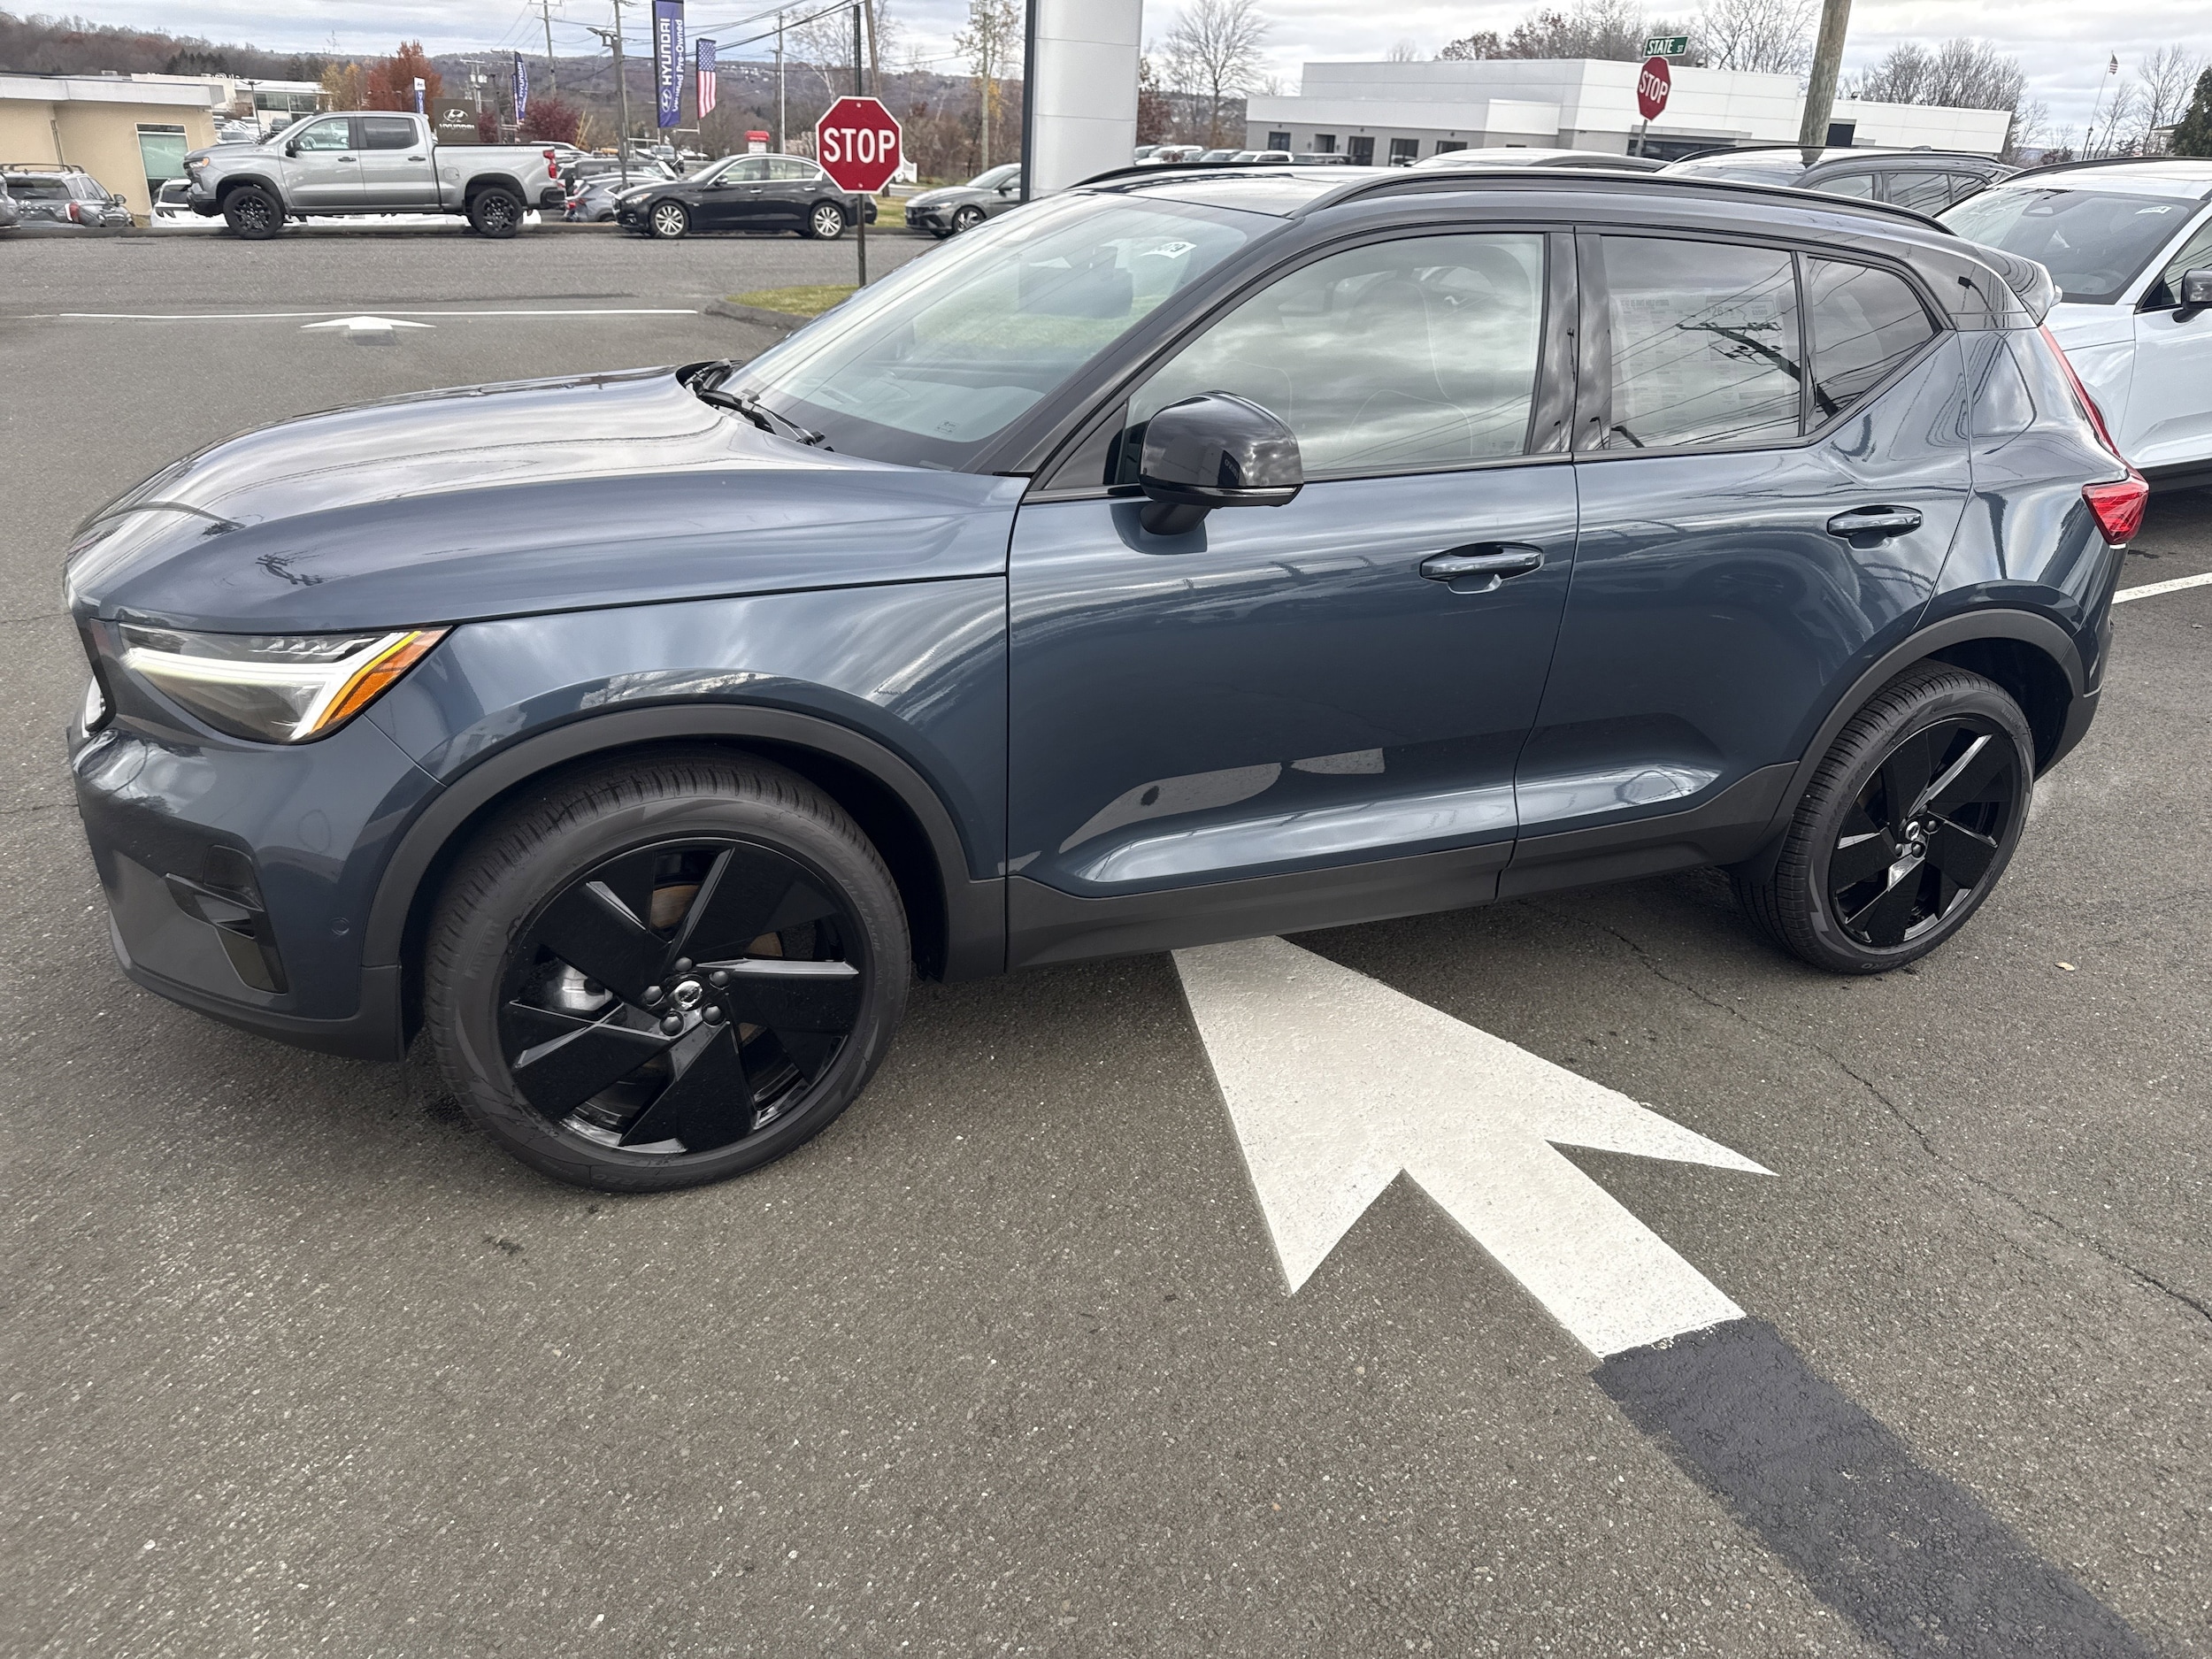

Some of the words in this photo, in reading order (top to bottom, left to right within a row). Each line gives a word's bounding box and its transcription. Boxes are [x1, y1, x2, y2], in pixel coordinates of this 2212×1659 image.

[659, 18, 672, 86] HYUNDAI
[675, 19, 685, 73] Pre-Owned
[1647, 39, 1675, 55] STATE
[1639, 70, 1669, 104] STOP
[823, 127, 896, 164] STOP
